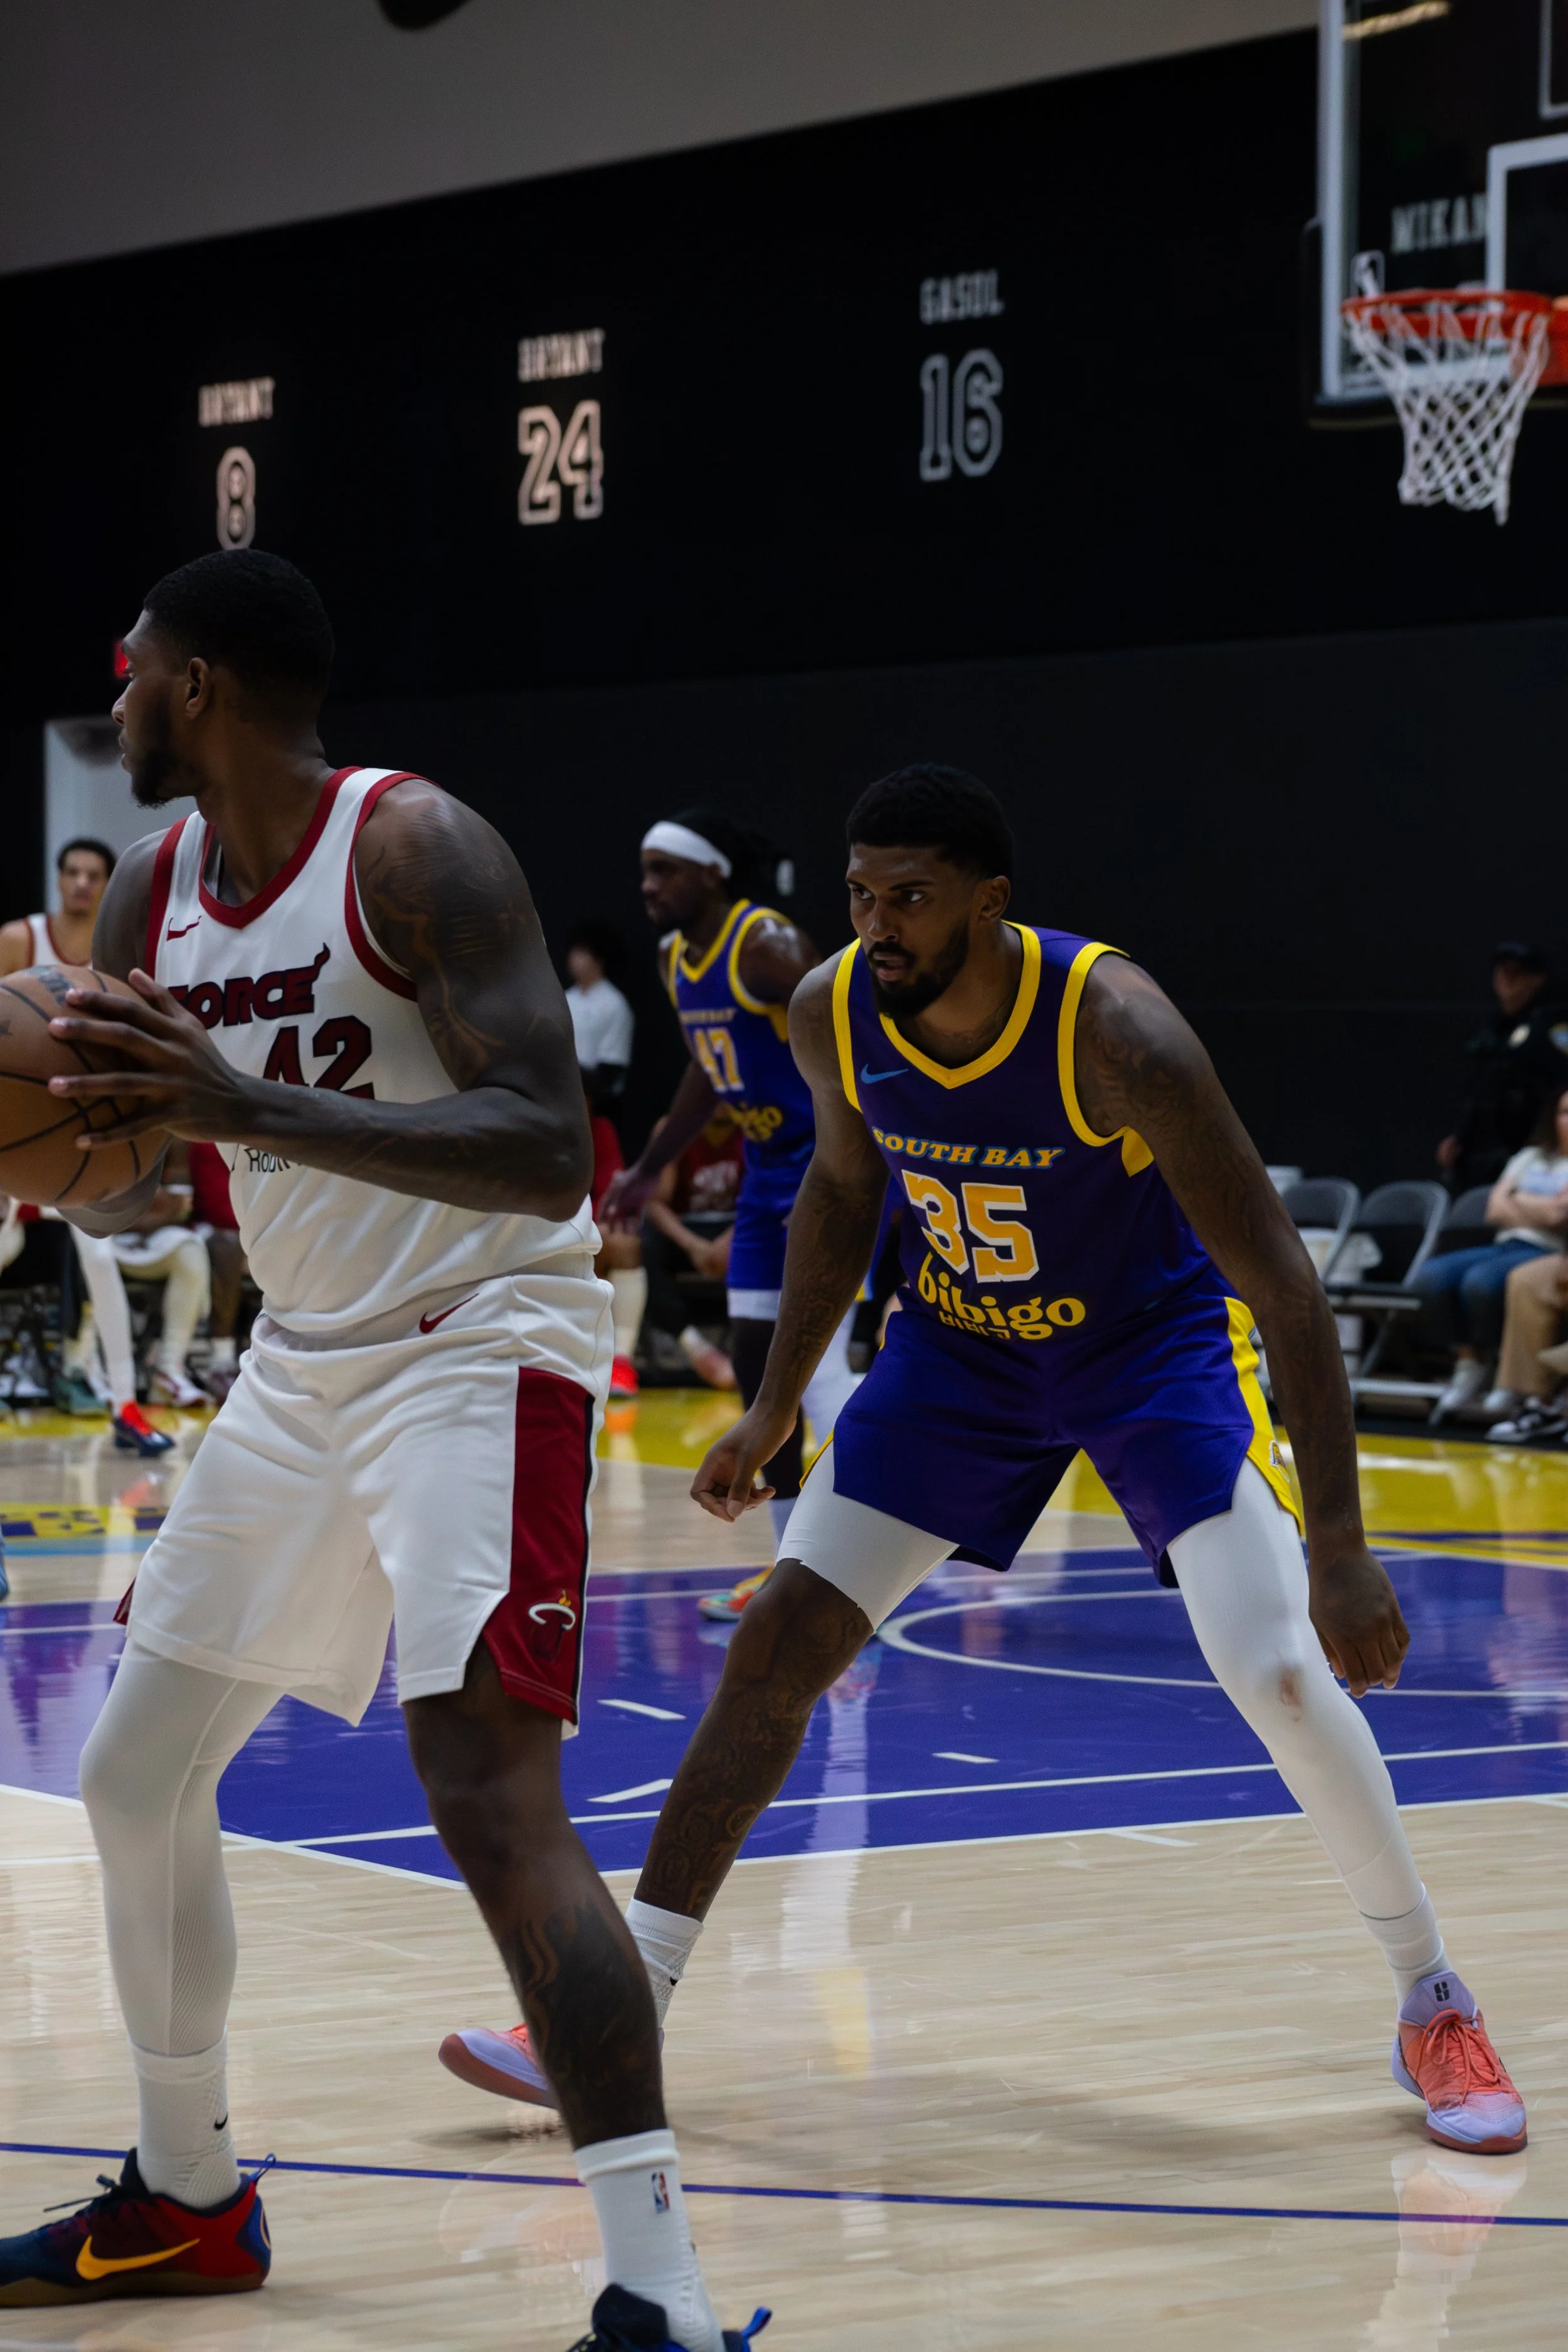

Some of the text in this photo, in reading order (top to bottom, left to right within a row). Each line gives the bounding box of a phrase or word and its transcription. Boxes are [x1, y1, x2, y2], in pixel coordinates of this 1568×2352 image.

[919, 269, 1004, 325] GASOL
[919, 347, 1004, 482] 16
[216, 446, 256, 549] 8
[517, 400, 604, 526] 24
[168, 942, 331, 1030] ORCE
[263, 1015, 375, 1099] 42
[872, 1126, 1066, 1168] SOUTH BAY
[901, 1169, 1040, 1283] 35
[918, 1251, 1086, 1340] bibigo
